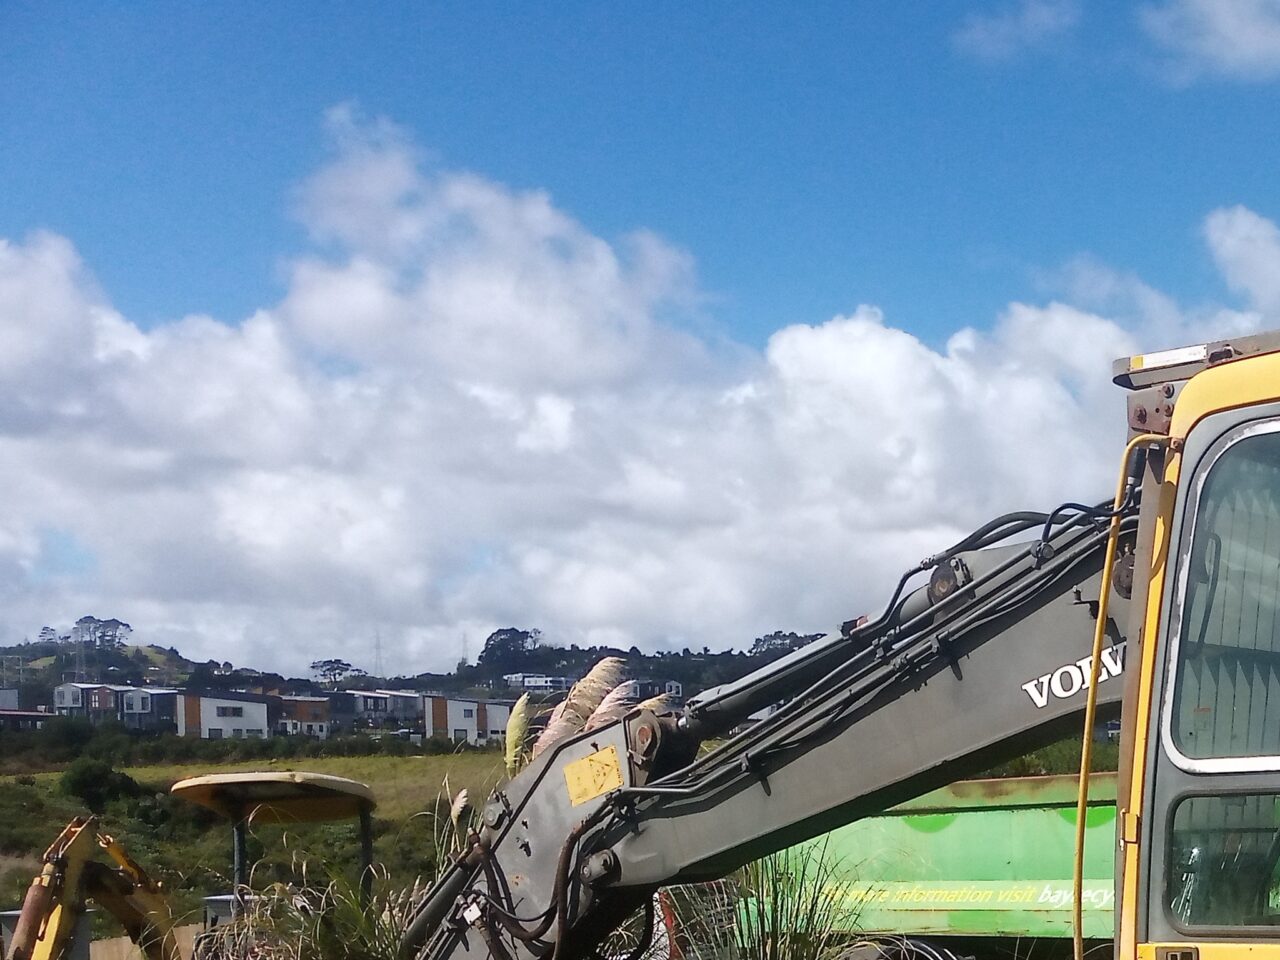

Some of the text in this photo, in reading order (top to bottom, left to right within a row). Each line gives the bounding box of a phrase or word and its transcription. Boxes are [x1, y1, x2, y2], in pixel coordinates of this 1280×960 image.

[890, 885, 993, 903] information
[998, 884, 1038, 903] visit
[1038, 883, 1115, 909] bayecy
